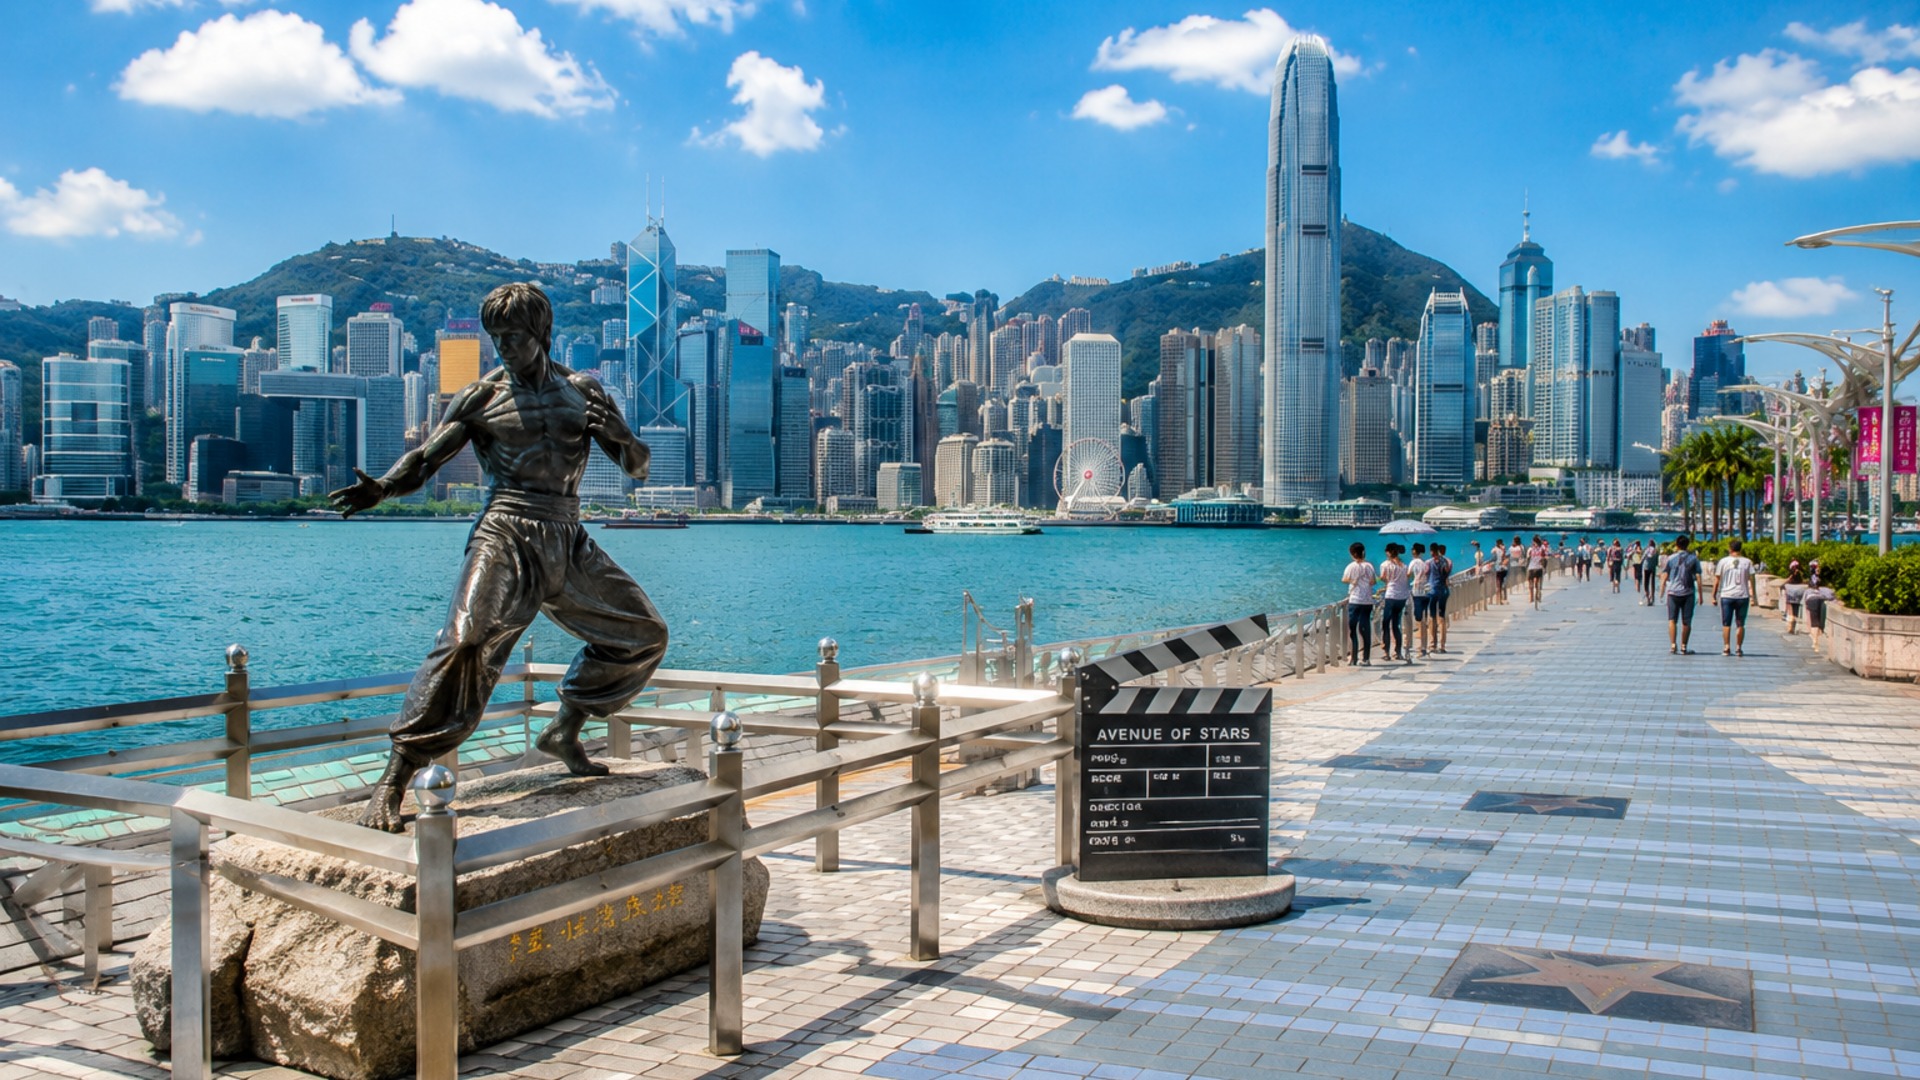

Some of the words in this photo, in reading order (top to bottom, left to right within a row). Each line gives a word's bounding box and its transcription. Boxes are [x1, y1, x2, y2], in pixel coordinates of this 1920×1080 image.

[1096, 728, 1162, 741] AVENUE
[1170, 728, 1191, 740] OF
[1200, 727, 1250, 740] STARS
